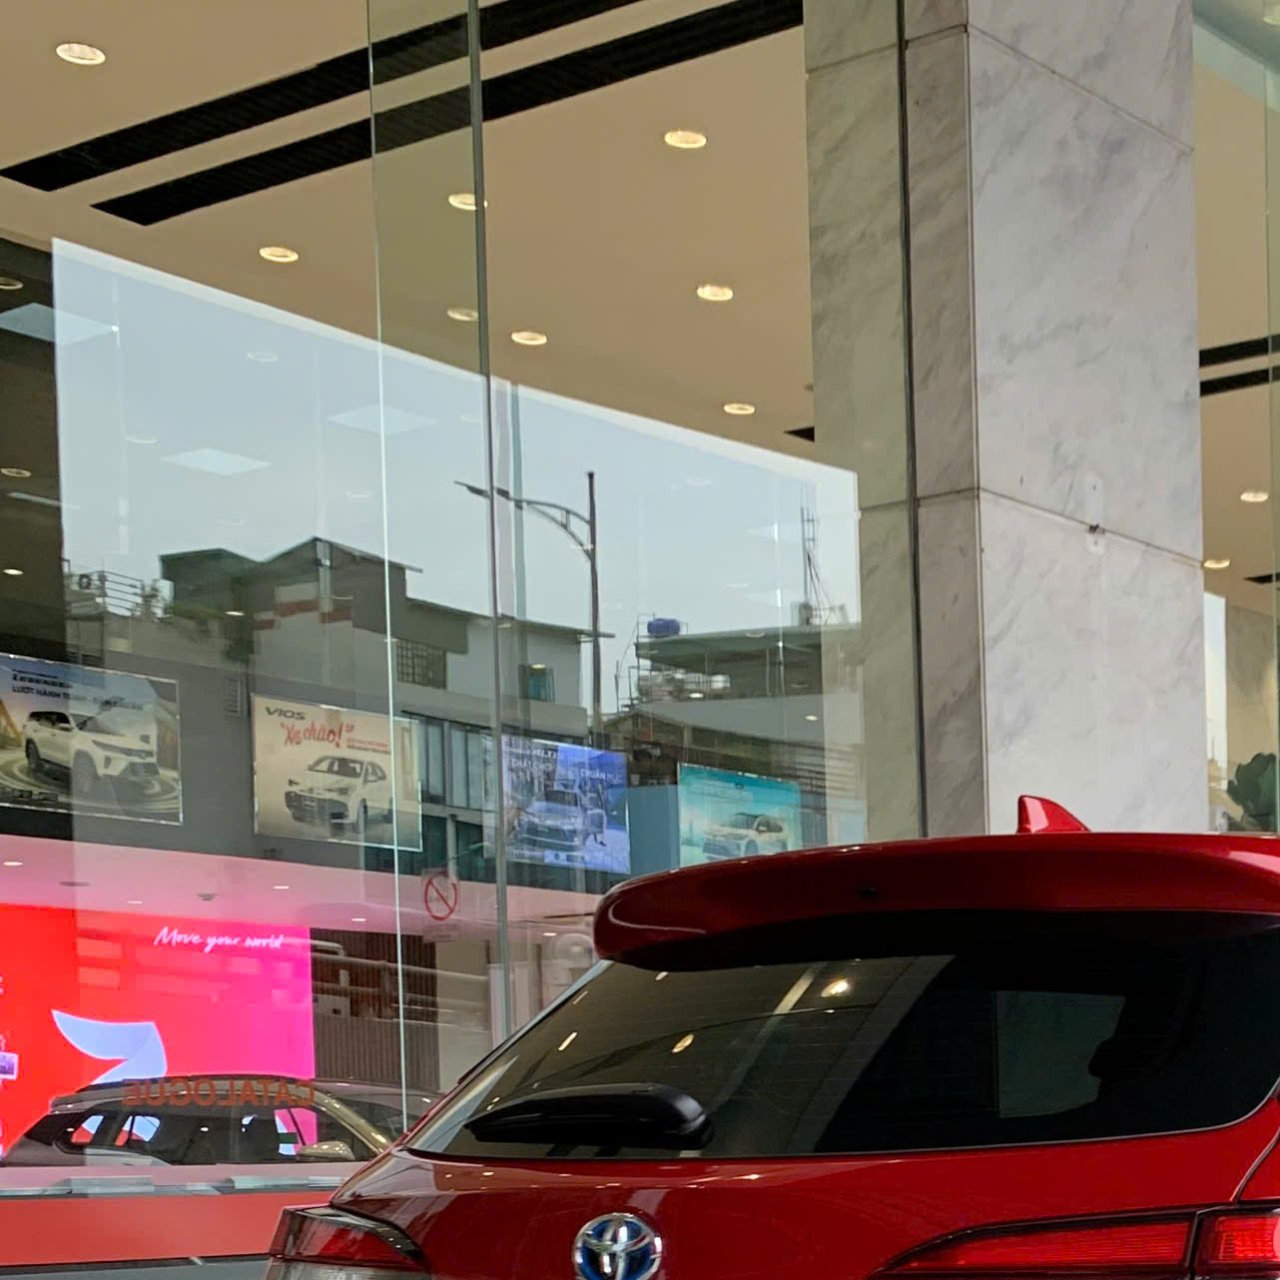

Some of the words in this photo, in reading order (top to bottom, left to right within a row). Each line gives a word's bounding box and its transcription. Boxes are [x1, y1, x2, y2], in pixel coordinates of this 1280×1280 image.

[265, 706, 306, 720] VIOS
[153, 926, 202, 946] Move
[204, 933, 241, 953] your
[244, 934, 284, 949] world
